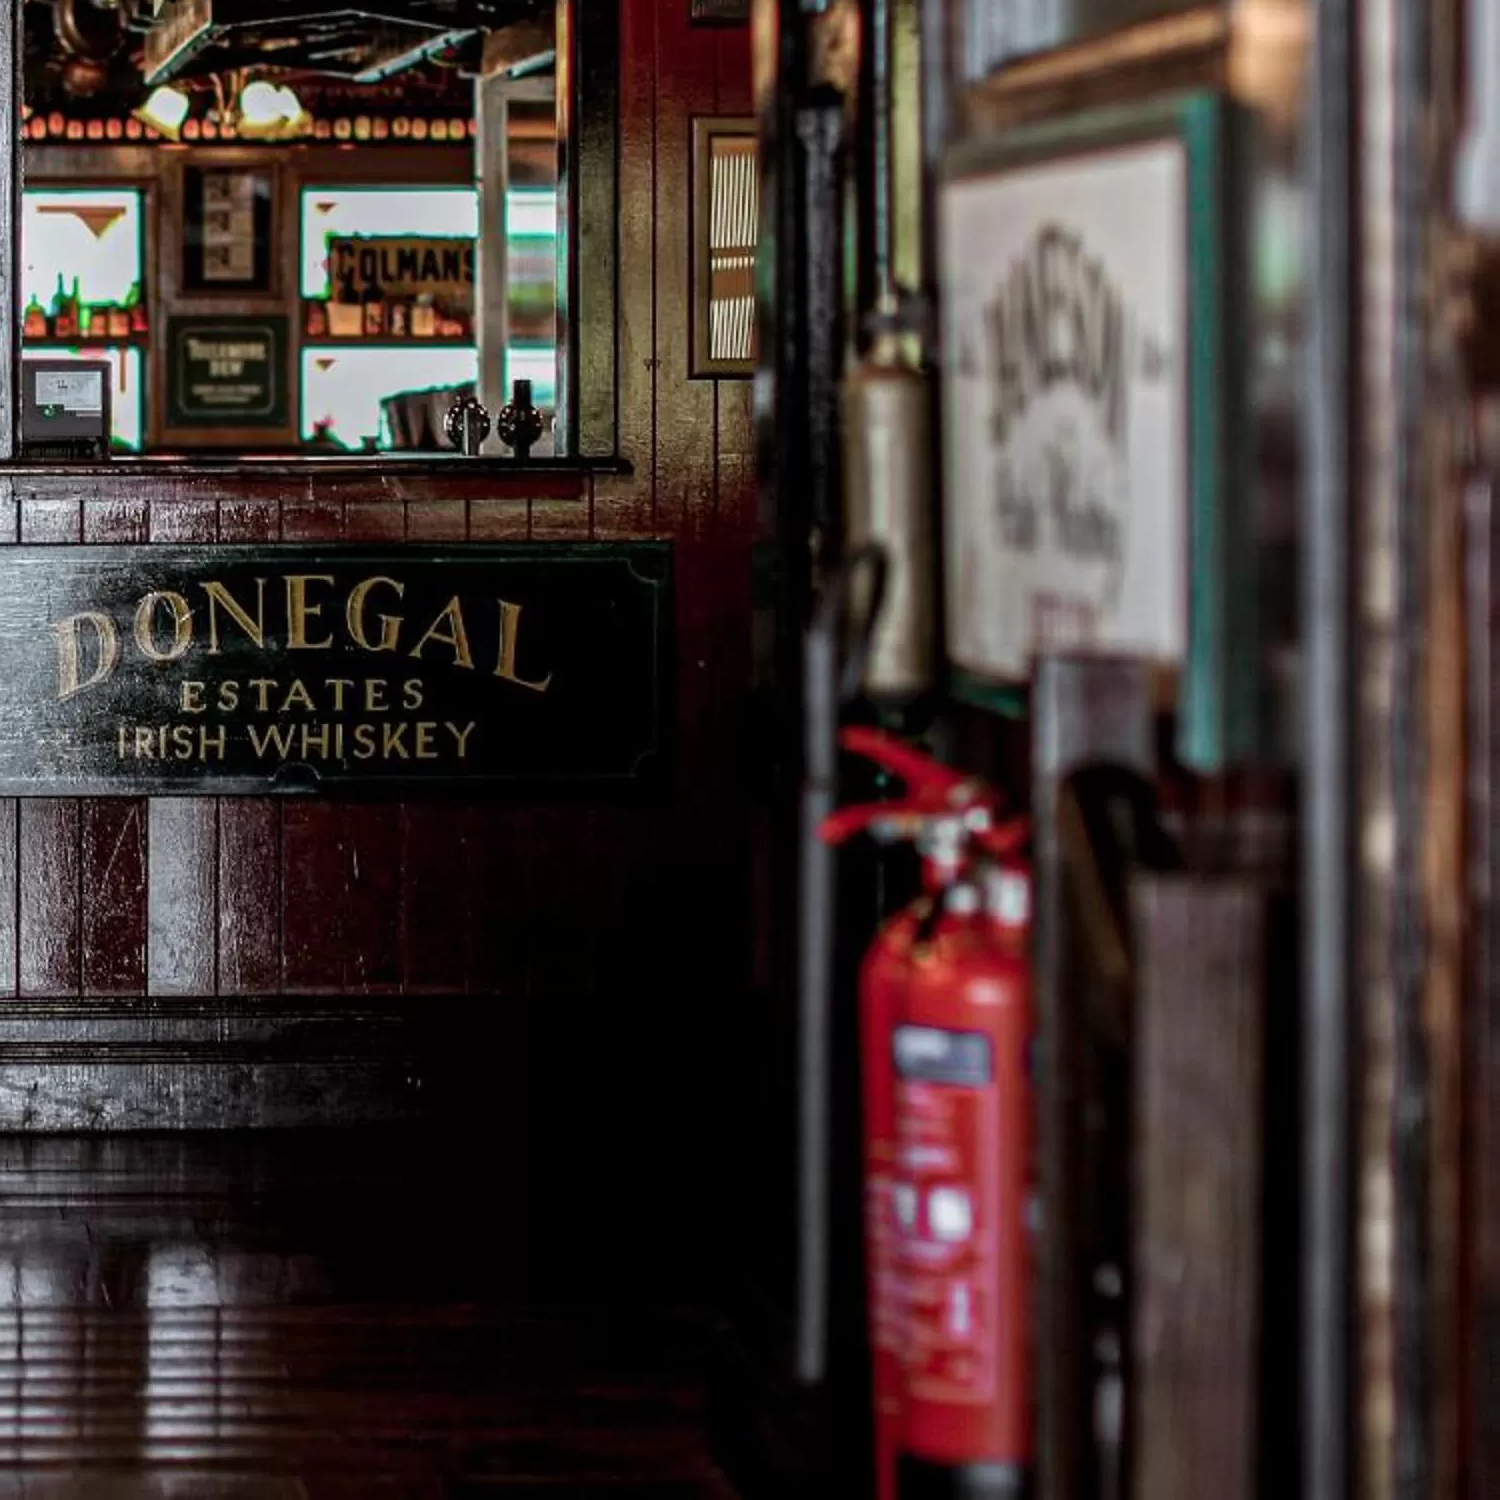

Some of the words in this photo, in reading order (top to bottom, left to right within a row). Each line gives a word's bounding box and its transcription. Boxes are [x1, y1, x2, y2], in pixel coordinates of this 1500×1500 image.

[50, 572, 553, 702] DONEGAL
[179, 678, 425, 714] ESTATES
[116, 722, 226, 761] IRISH
[246, 720, 477, 761] WHISKEY
